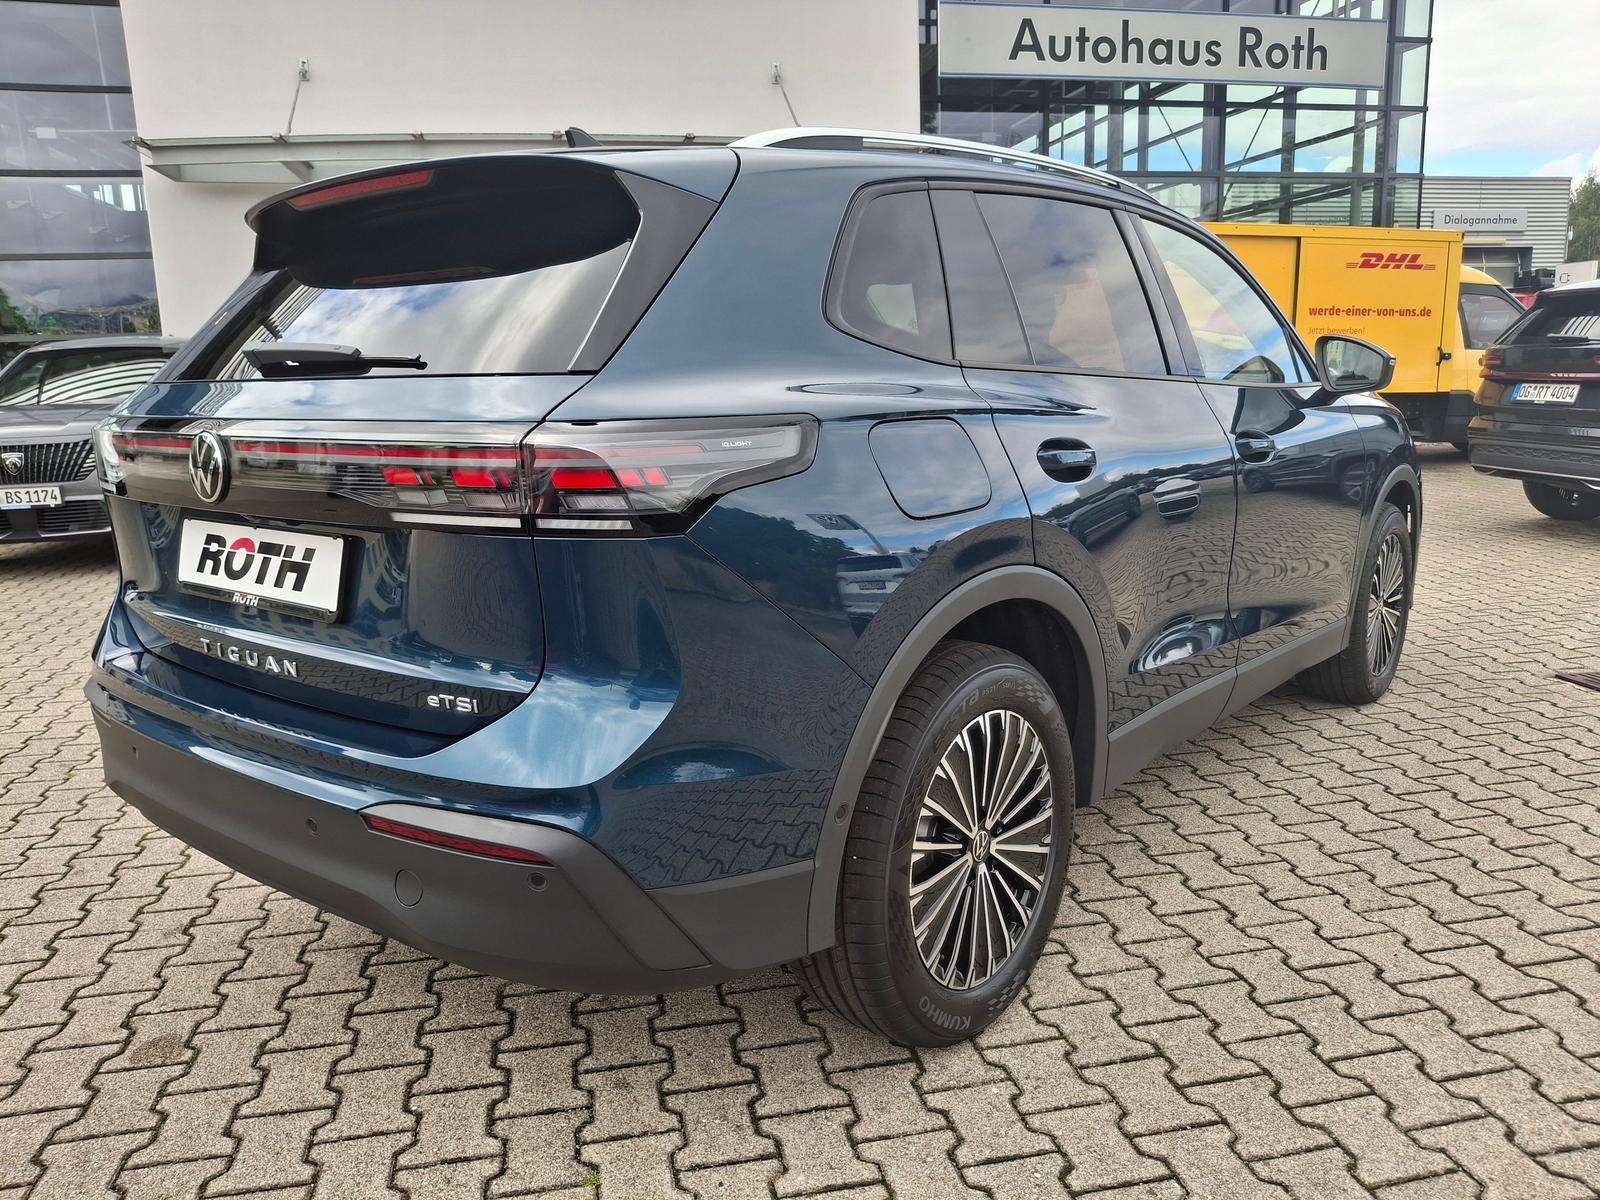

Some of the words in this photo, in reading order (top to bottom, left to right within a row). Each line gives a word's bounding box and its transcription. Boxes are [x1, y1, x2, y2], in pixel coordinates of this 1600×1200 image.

[1008, 17, 1223, 67] Autohaus
[1237, 26, 1328, 71] Roth
[1444, 214, 1518, 227] Dialogannahme
[1358, 252, 1425, 270] DHL
[1308, 305, 1432, 317] werde-einer-von-uns.de
[1308, 326, 1325, 335] Jetzt
[1551, 386, 1576, 400] 4004
[196, 533, 317, 592] ROTH
[232, 592, 260, 607] ROTH
[200, 637, 299, 678] TIGUAN
[919, 995, 972, 1031] KUMHO
